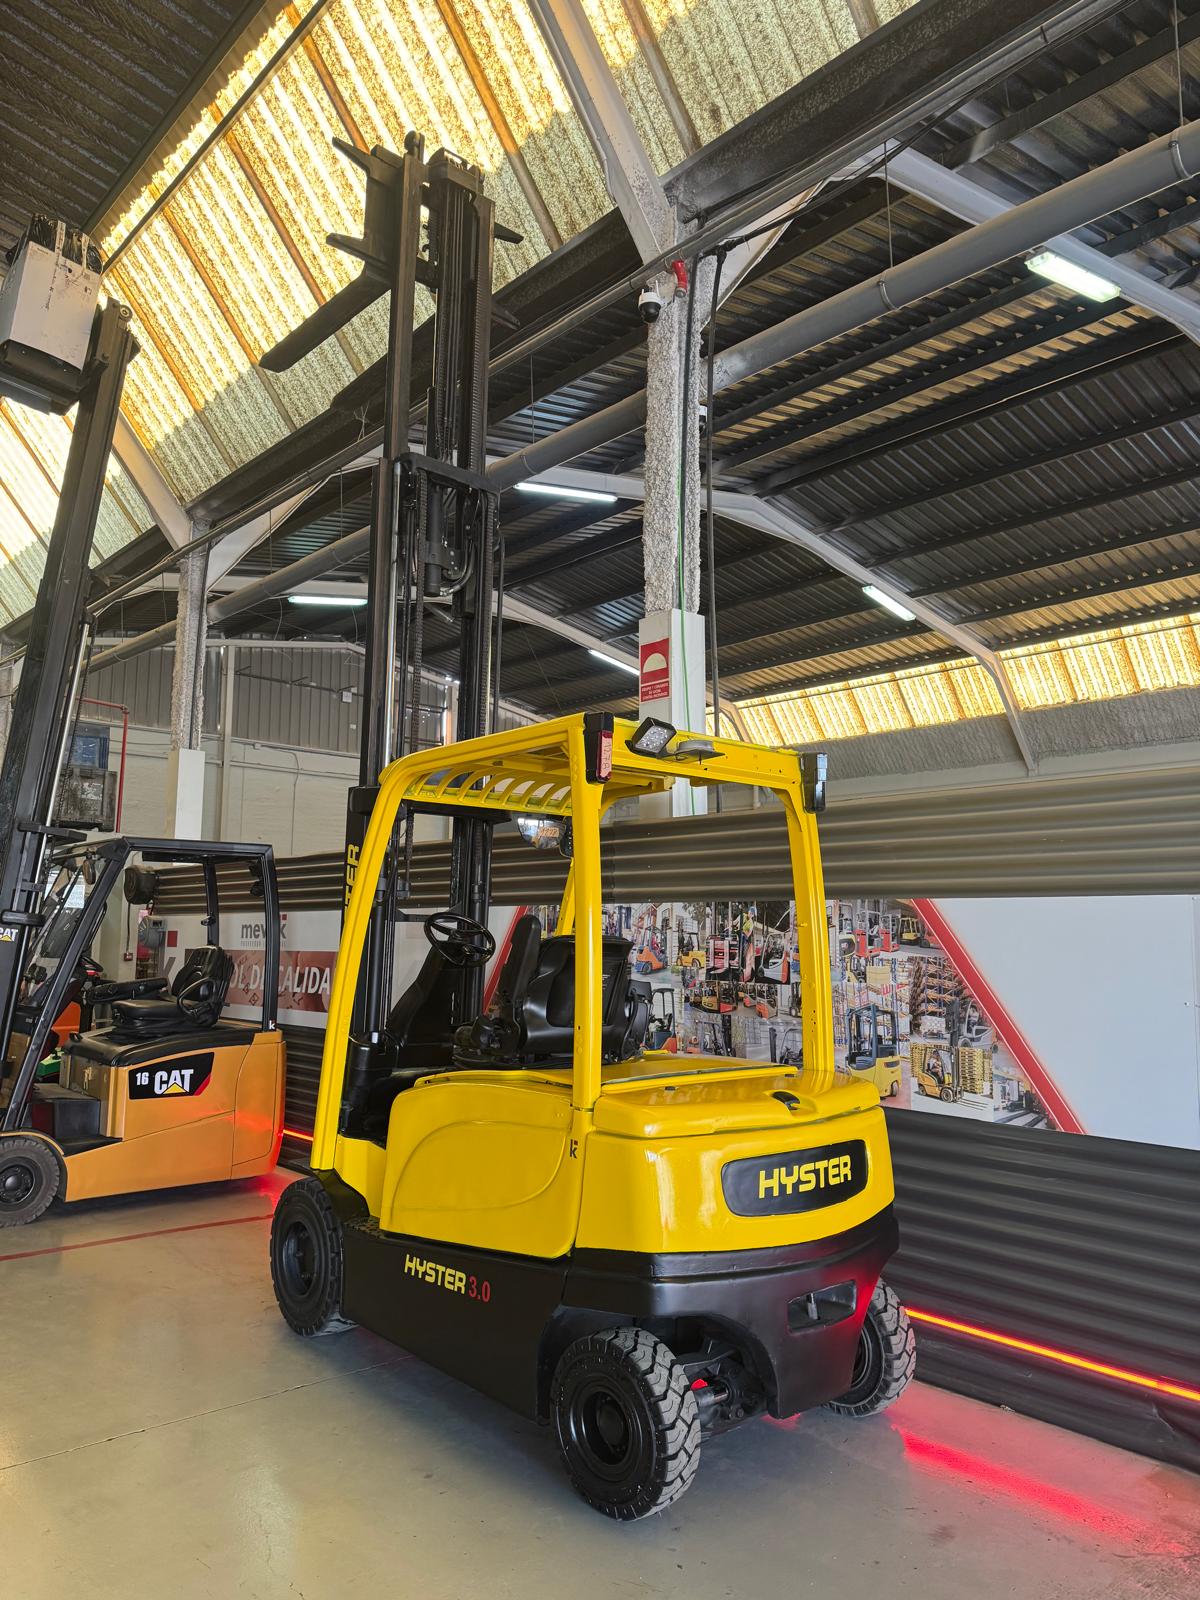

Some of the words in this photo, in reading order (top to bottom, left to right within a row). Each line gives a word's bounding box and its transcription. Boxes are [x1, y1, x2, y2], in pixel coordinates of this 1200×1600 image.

[136, 1072, 150, 1086] 16
[154, 1068, 194, 1095] CAT
[758, 1154, 852, 1199] HYSTER
[404, 1253, 467, 1295] HYSTER
[468, 1275, 491, 1302] 3.0
